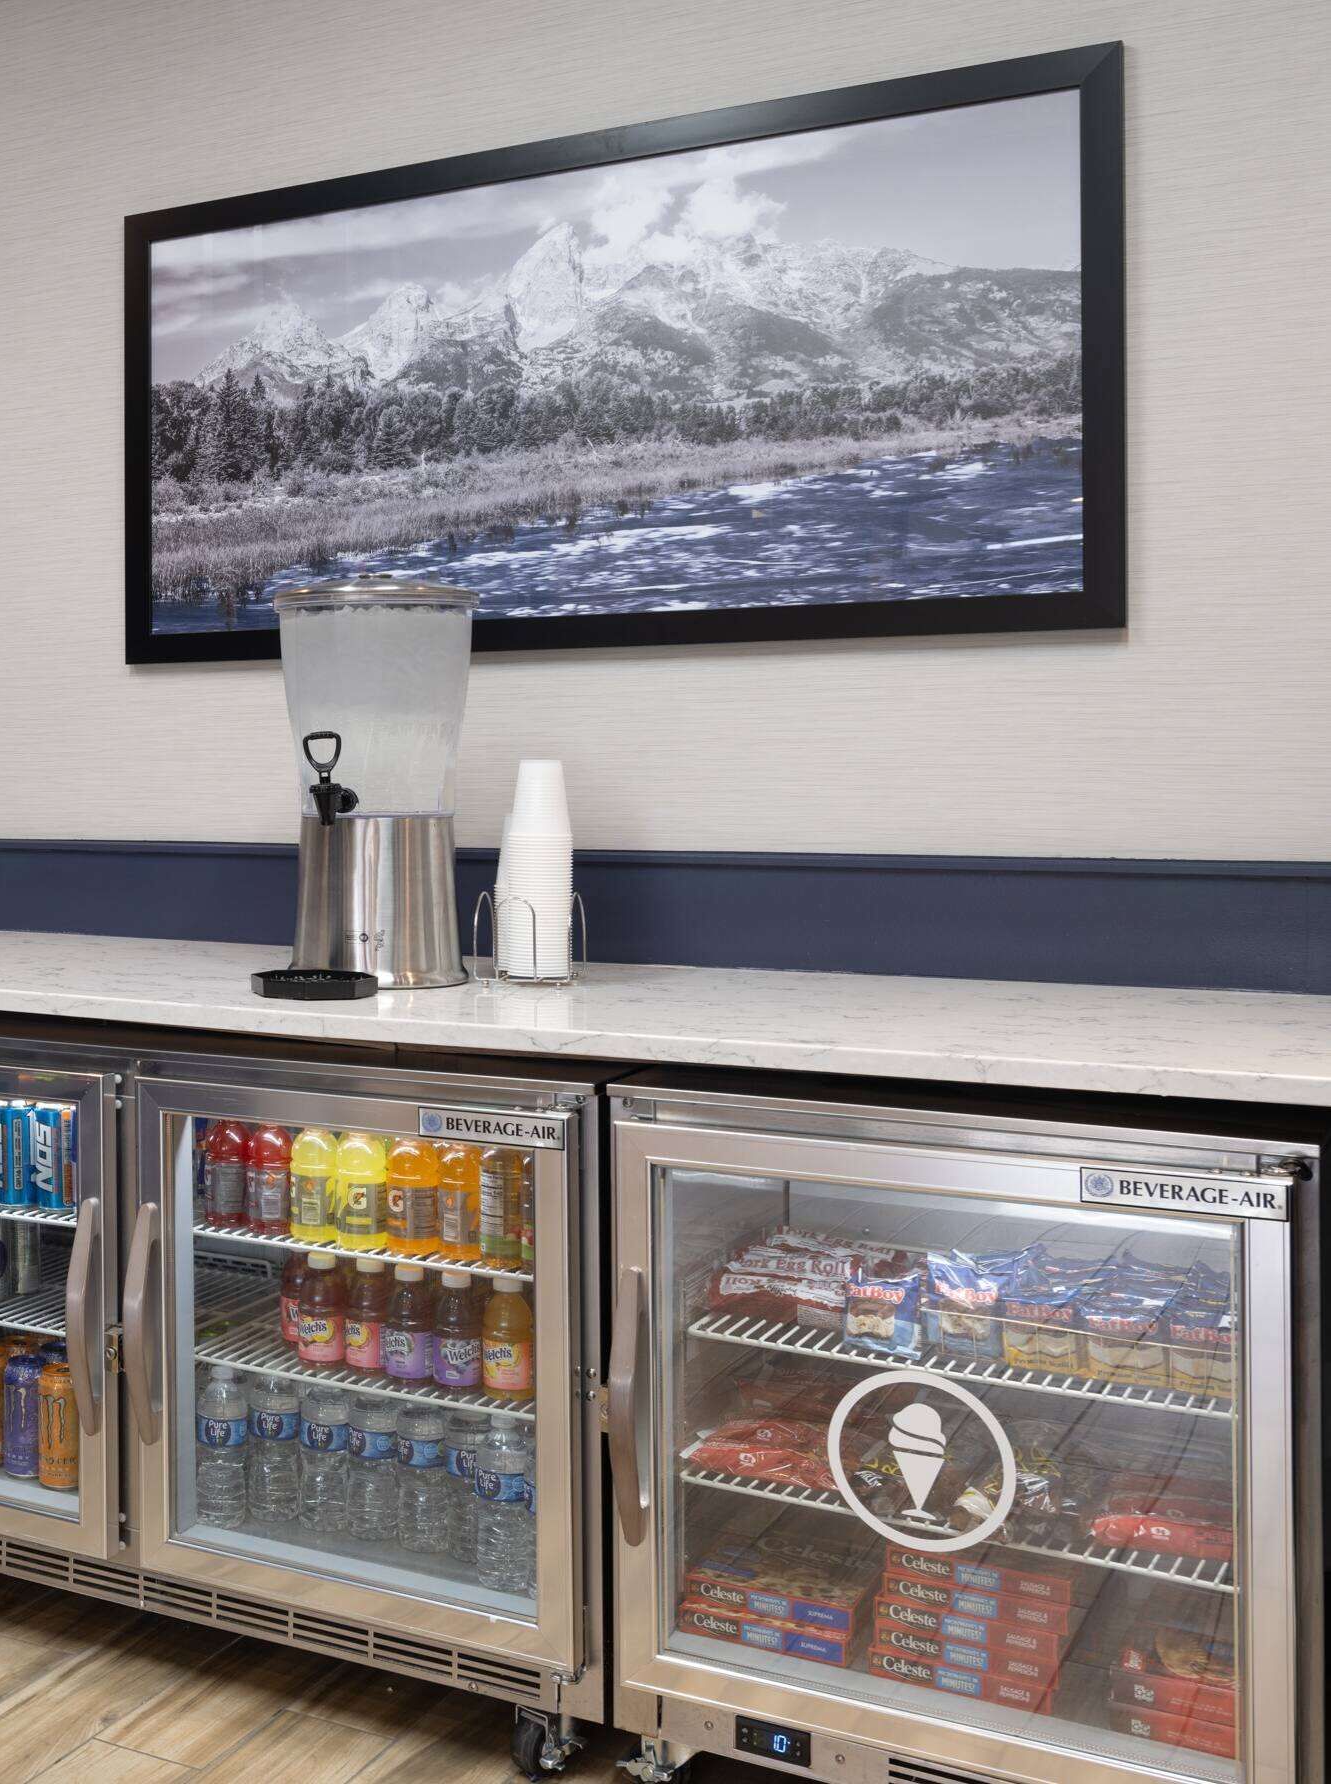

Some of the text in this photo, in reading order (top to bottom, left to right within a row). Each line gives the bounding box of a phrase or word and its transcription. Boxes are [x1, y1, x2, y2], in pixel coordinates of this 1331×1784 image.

[445, 1116, 556, 1140] BEVERAGE-AIR
[1119, 1178, 1278, 1209] BEVERAGE-AIR
[208, 1419, 228, 1431] Pure
[260, 1412, 280, 1424] Pure
[262, 1420, 278, 1430] Life
[211, 1427, 226, 1437] Life
[310, 1424, 331, 1436] Pure
[312, 1432, 327, 1444] Life
[478, 1469, 496, 1482] Pure
[480, 1478, 494, 1489] Life
[901, 1553, 951, 1576] Celeste
[701, 1583, 744, 1603] Celeste
[899, 1581, 948, 1603] Celeste
[694, 1613, 737, 1634] Celeste
[889, 1604, 937, 1627] Celeste
[891, 1632, 940, 1654] Celeste
[882, 1655, 931, 1678] Celeste
